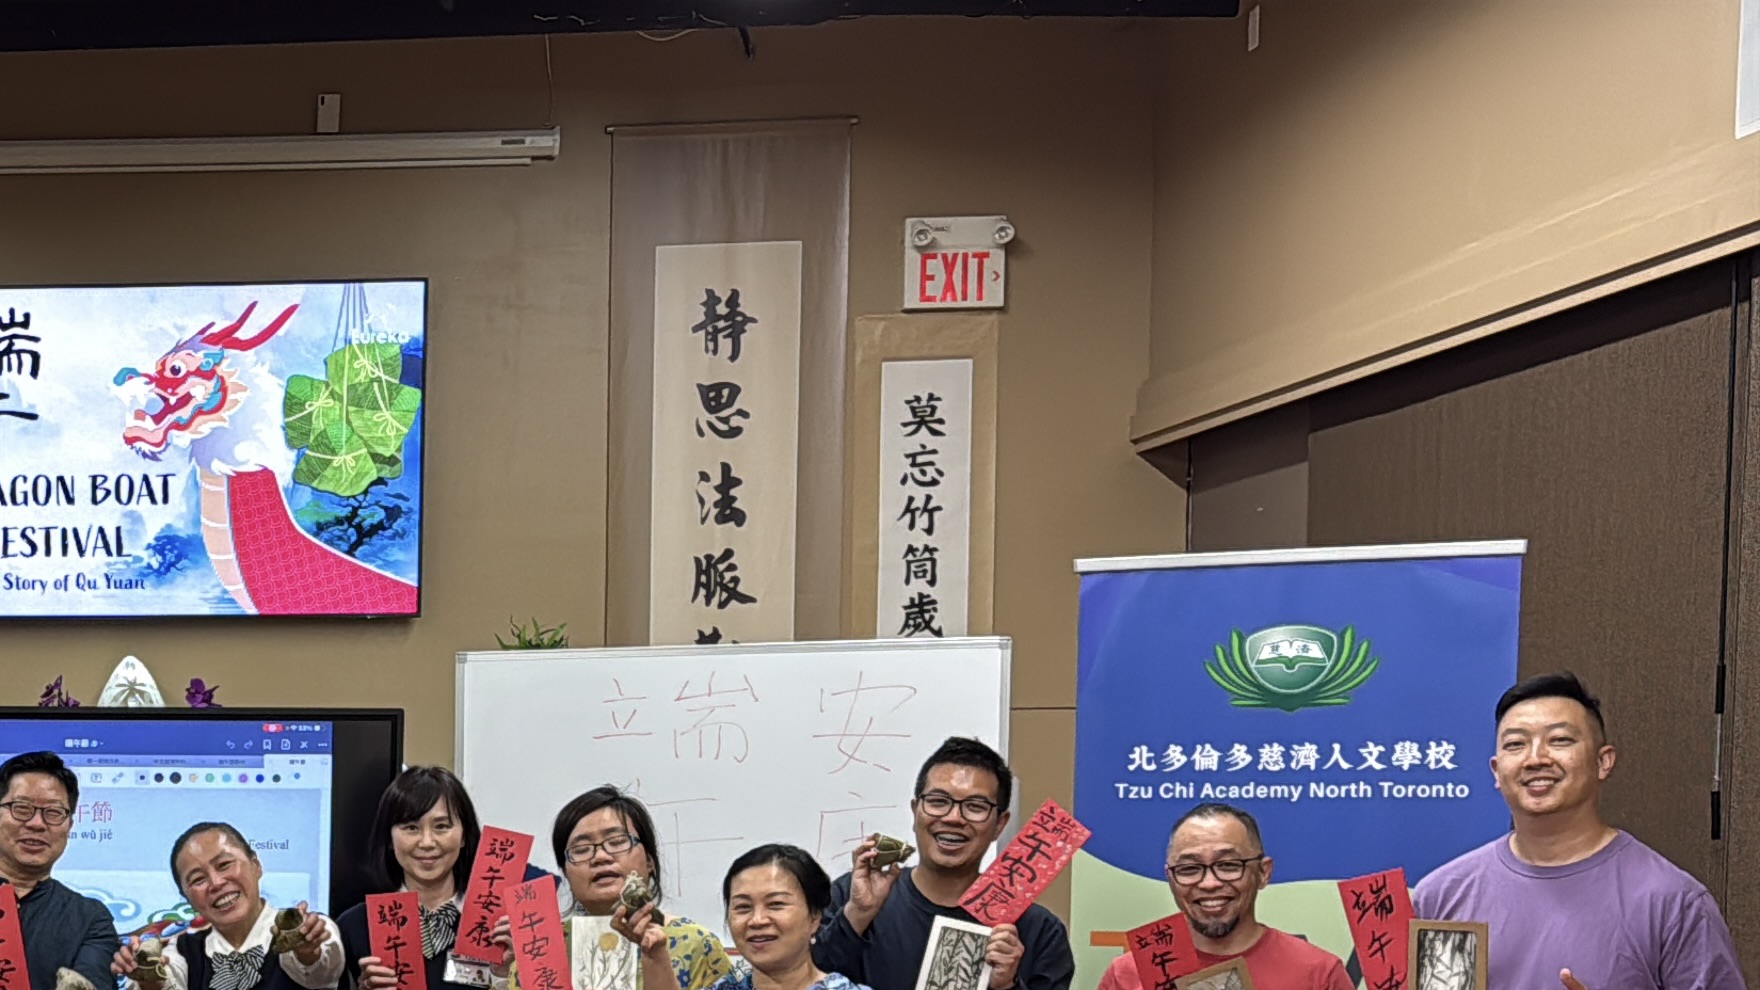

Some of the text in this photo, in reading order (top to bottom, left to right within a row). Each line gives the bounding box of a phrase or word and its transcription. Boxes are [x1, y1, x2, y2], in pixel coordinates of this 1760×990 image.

[919, 252, 990, 303] EXIT
[90, 473, 176, 506] BOAT
[896, 392, 947, 638] 莫忘竹筒歲
[3, 572, 48, 595] Story
[53, 574, 71, 592] of
[75, 572, 97, 590] Qu
[104, 572, 146, 590] Yuan
[1127, 740, 1459, 773] 北多倫多慈濟人文學校
[1115, 780, 1470, 803] Tzu Chi Academy North Toronto
[79, 801, 113, 823] 午節
[466, 838, 515, 948] 端午安康
